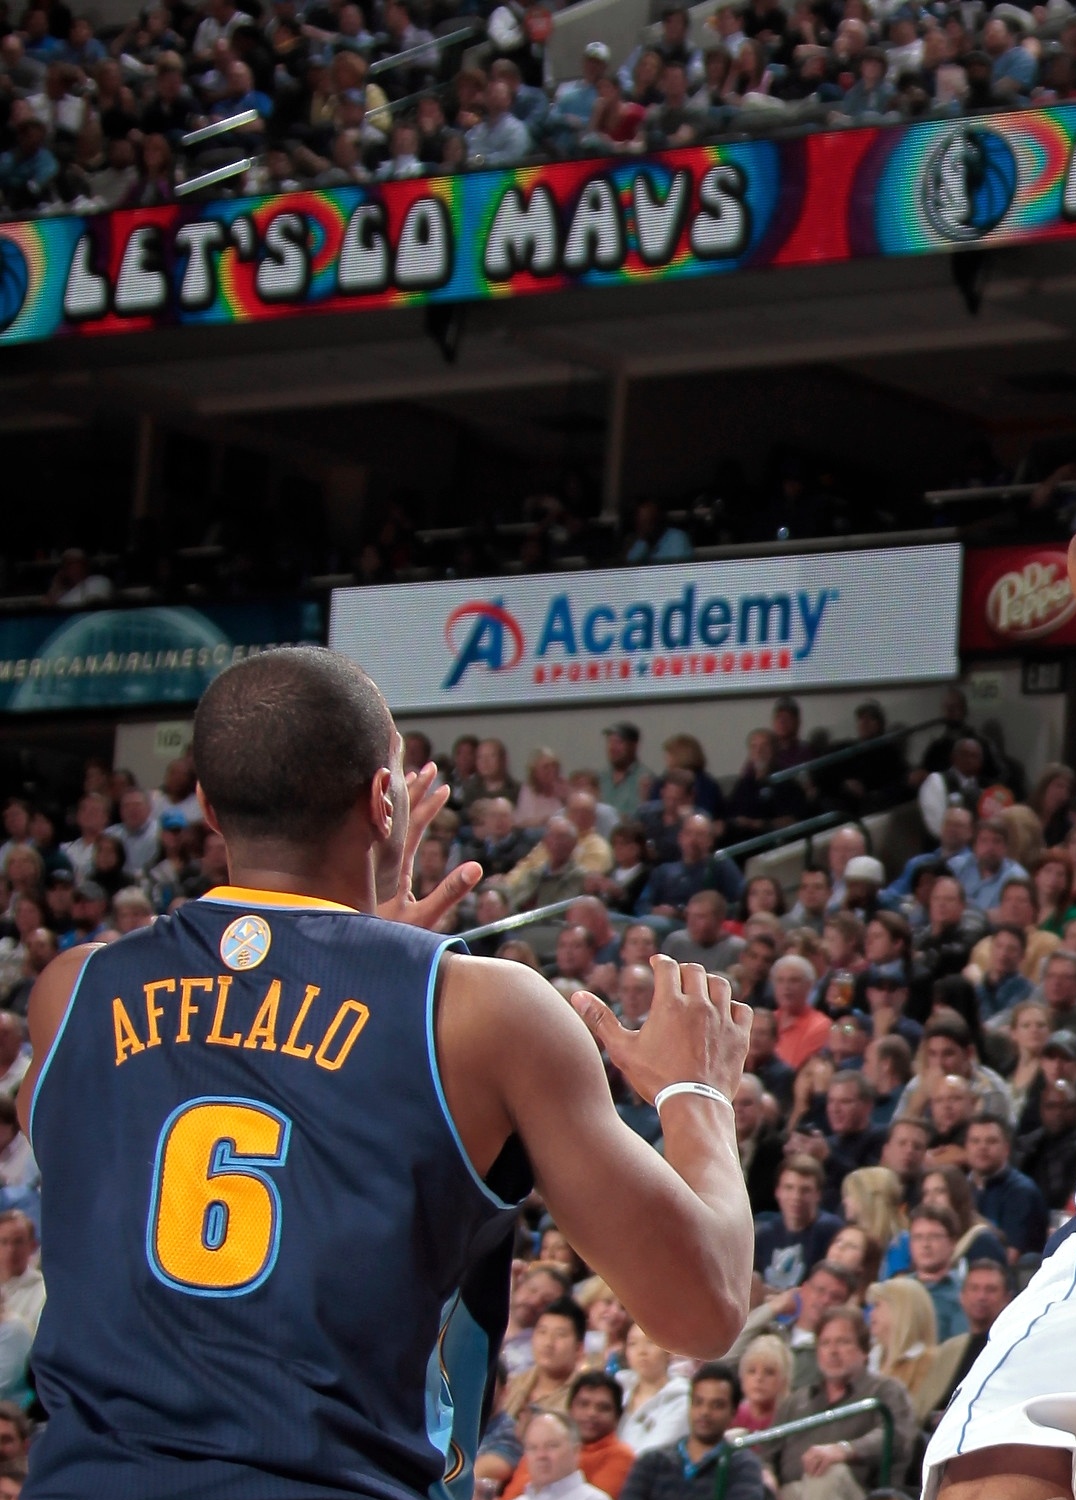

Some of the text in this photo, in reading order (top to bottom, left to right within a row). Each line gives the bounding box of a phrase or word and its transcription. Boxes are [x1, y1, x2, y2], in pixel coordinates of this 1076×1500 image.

[64, 165, 746, 316] LET'S GO MAVS
[536, 583, 838, 660] Academy
[112, 975, 370, 1071] AFFLALO
[146, 1095, 292, 1298] 6
